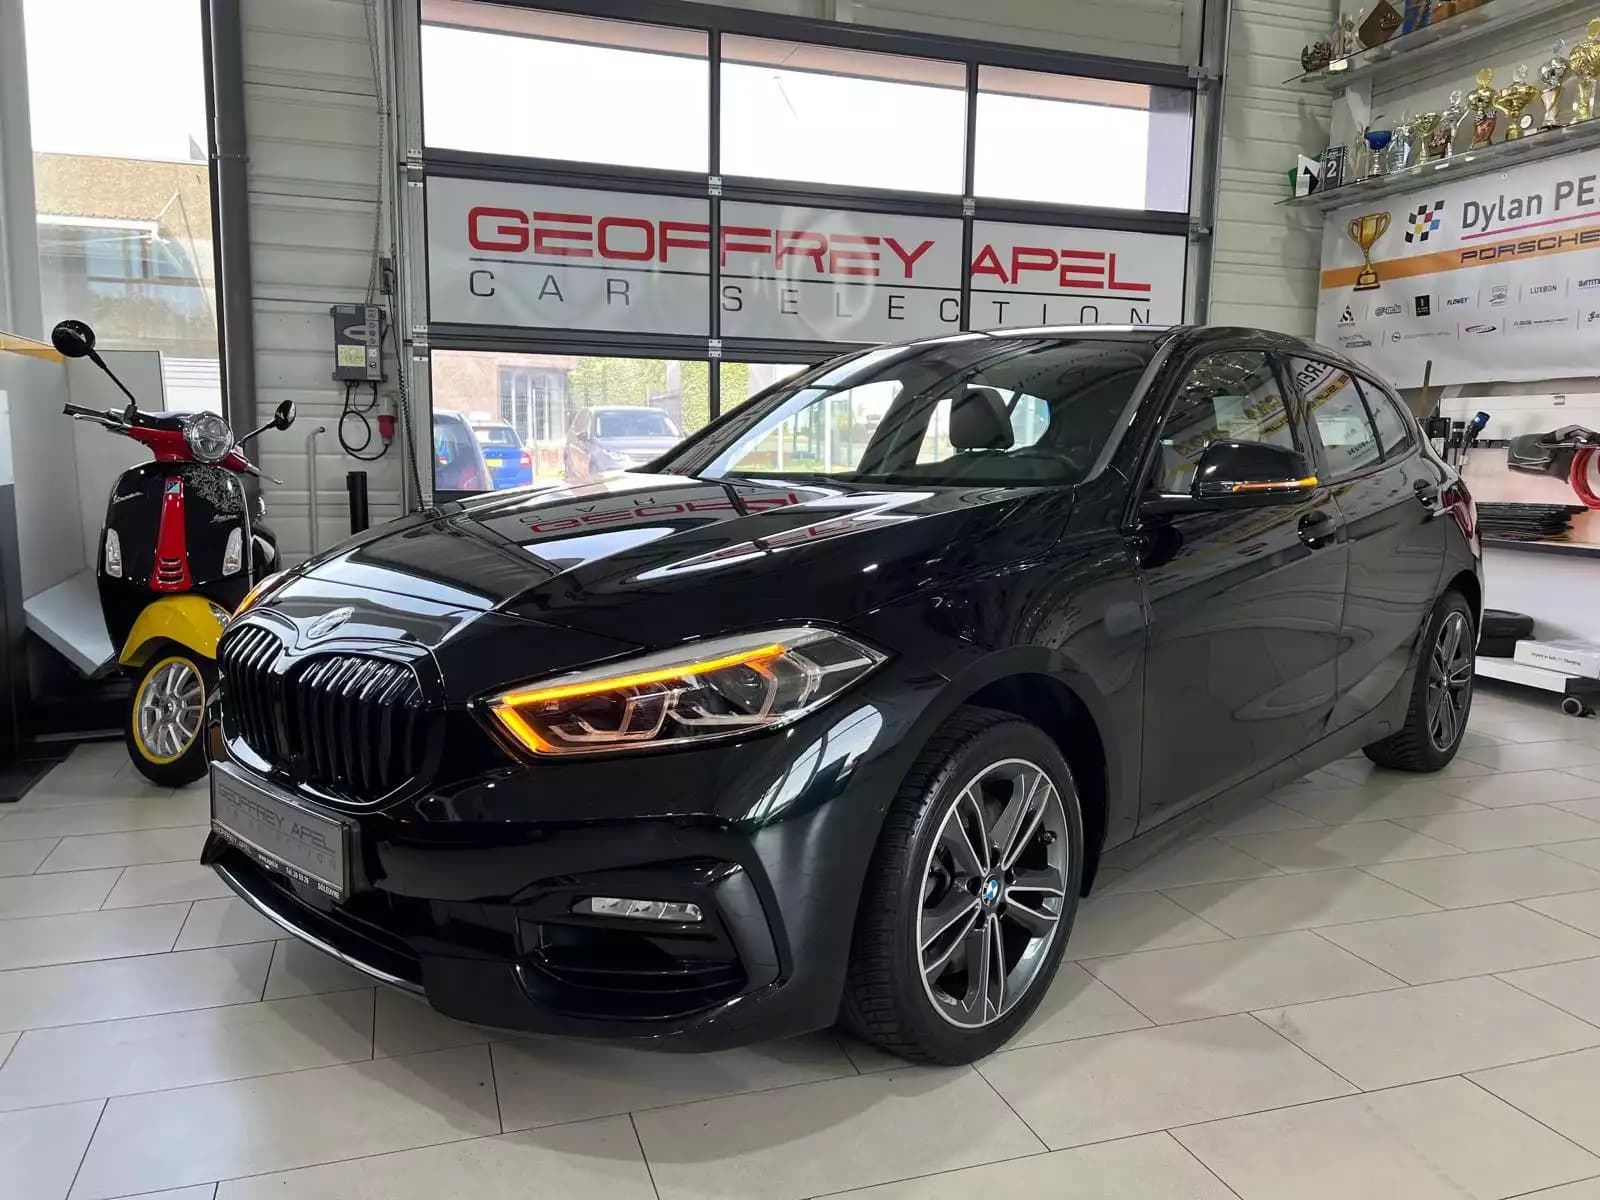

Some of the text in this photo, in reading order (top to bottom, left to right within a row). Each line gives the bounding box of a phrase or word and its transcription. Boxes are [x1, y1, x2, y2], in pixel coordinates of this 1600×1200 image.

[1462, 175, 1600, 232] Dylan PE
[468, 206, 1151, 292] GEOFFREY APEL
[1460, 229, 1600, 263] PORSCHE
[469, 270, 1150, 324] CAR SELECTION
